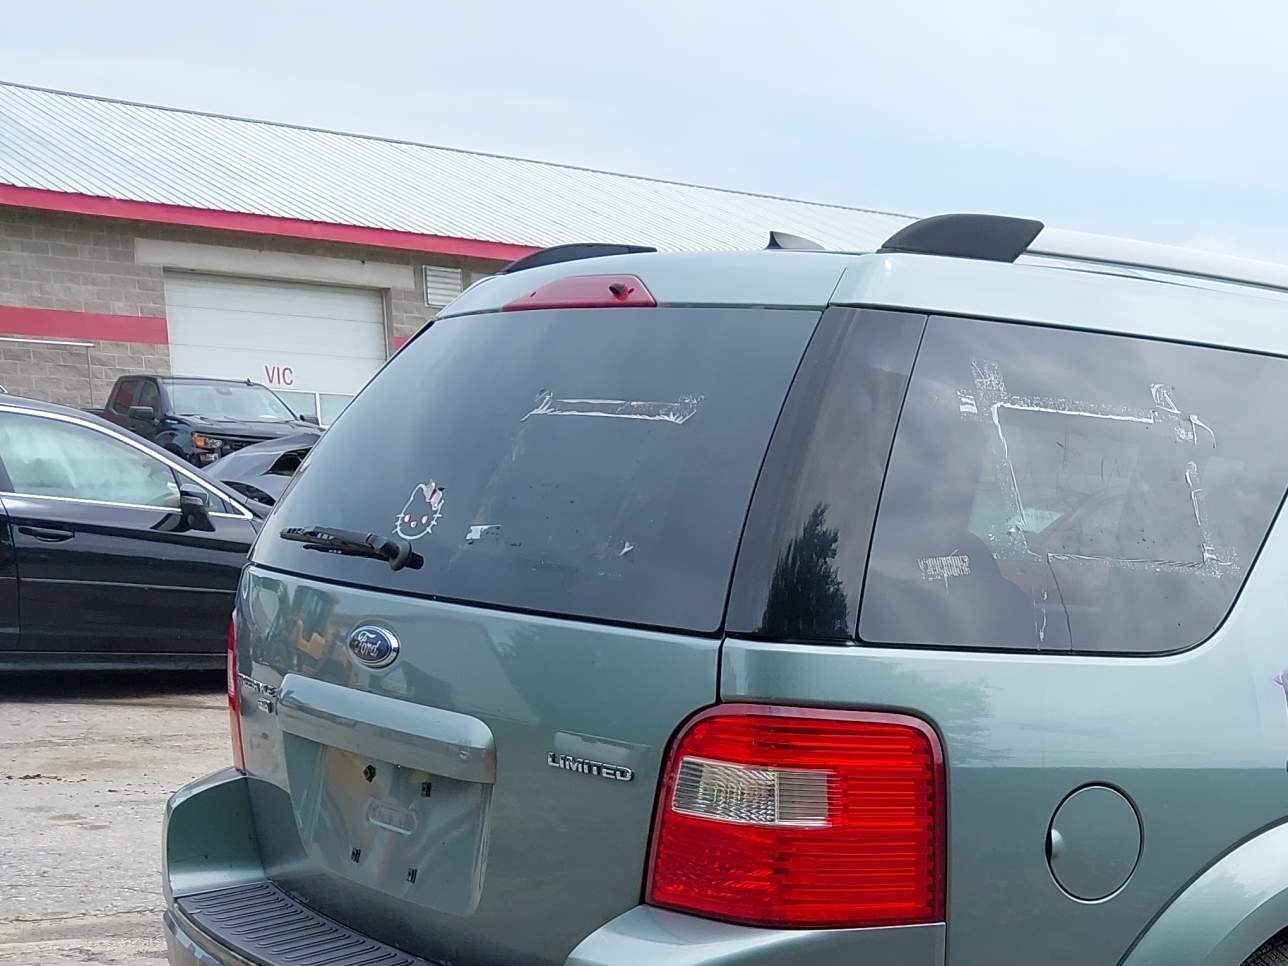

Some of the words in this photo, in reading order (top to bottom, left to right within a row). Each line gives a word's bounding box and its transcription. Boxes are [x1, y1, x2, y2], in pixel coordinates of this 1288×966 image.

[264, 365, 293, 386] VIC
[356, 630, 382, 657] Ford
[547, 751, 634, 782] LIMITED
